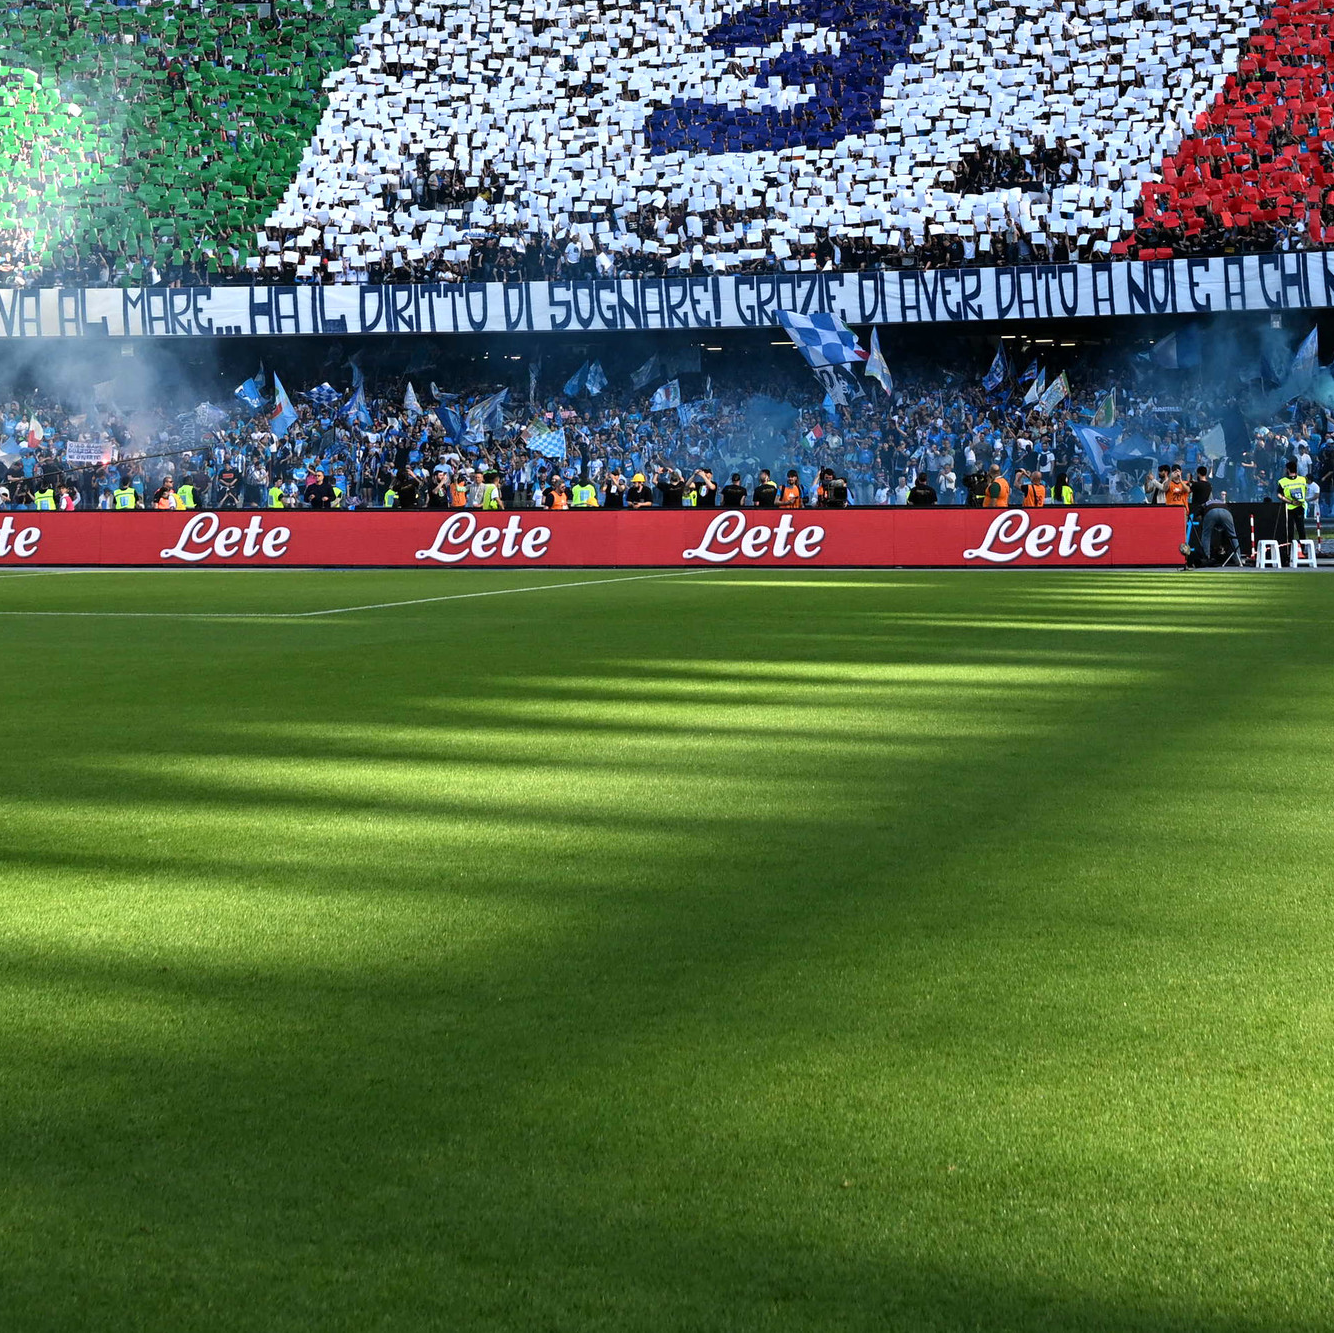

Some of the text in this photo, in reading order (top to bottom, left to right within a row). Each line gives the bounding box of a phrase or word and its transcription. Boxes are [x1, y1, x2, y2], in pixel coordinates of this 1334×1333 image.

[59, 288, 107, 337] AL
[249, 286, 300, 334] HA
[311, 285, 347, 334] IL
[360, 283, 487, 333] DIRITTO
[503, 281, 535, 331] DI
[734, 273, 846, 326] GRAZIE
[858, 272, 887, 323] DI
[898, 268, 983, 323] AVER
[995, 264, 1078, 321] DATO
[1091, 262, 1115, 316] A
[1127, 259, 1177, 314] NOI
[1187, 258, 1211, 312] E
[1223, 256, 1245, 310] A
[1258, 252, 1312, 309] CHI
[160, 512, 291, 562] Lete
[415, 511, 552, 563] Lete
[682, 510, 825, 562] Lete
[963, 509, 1113, 562] Lete
